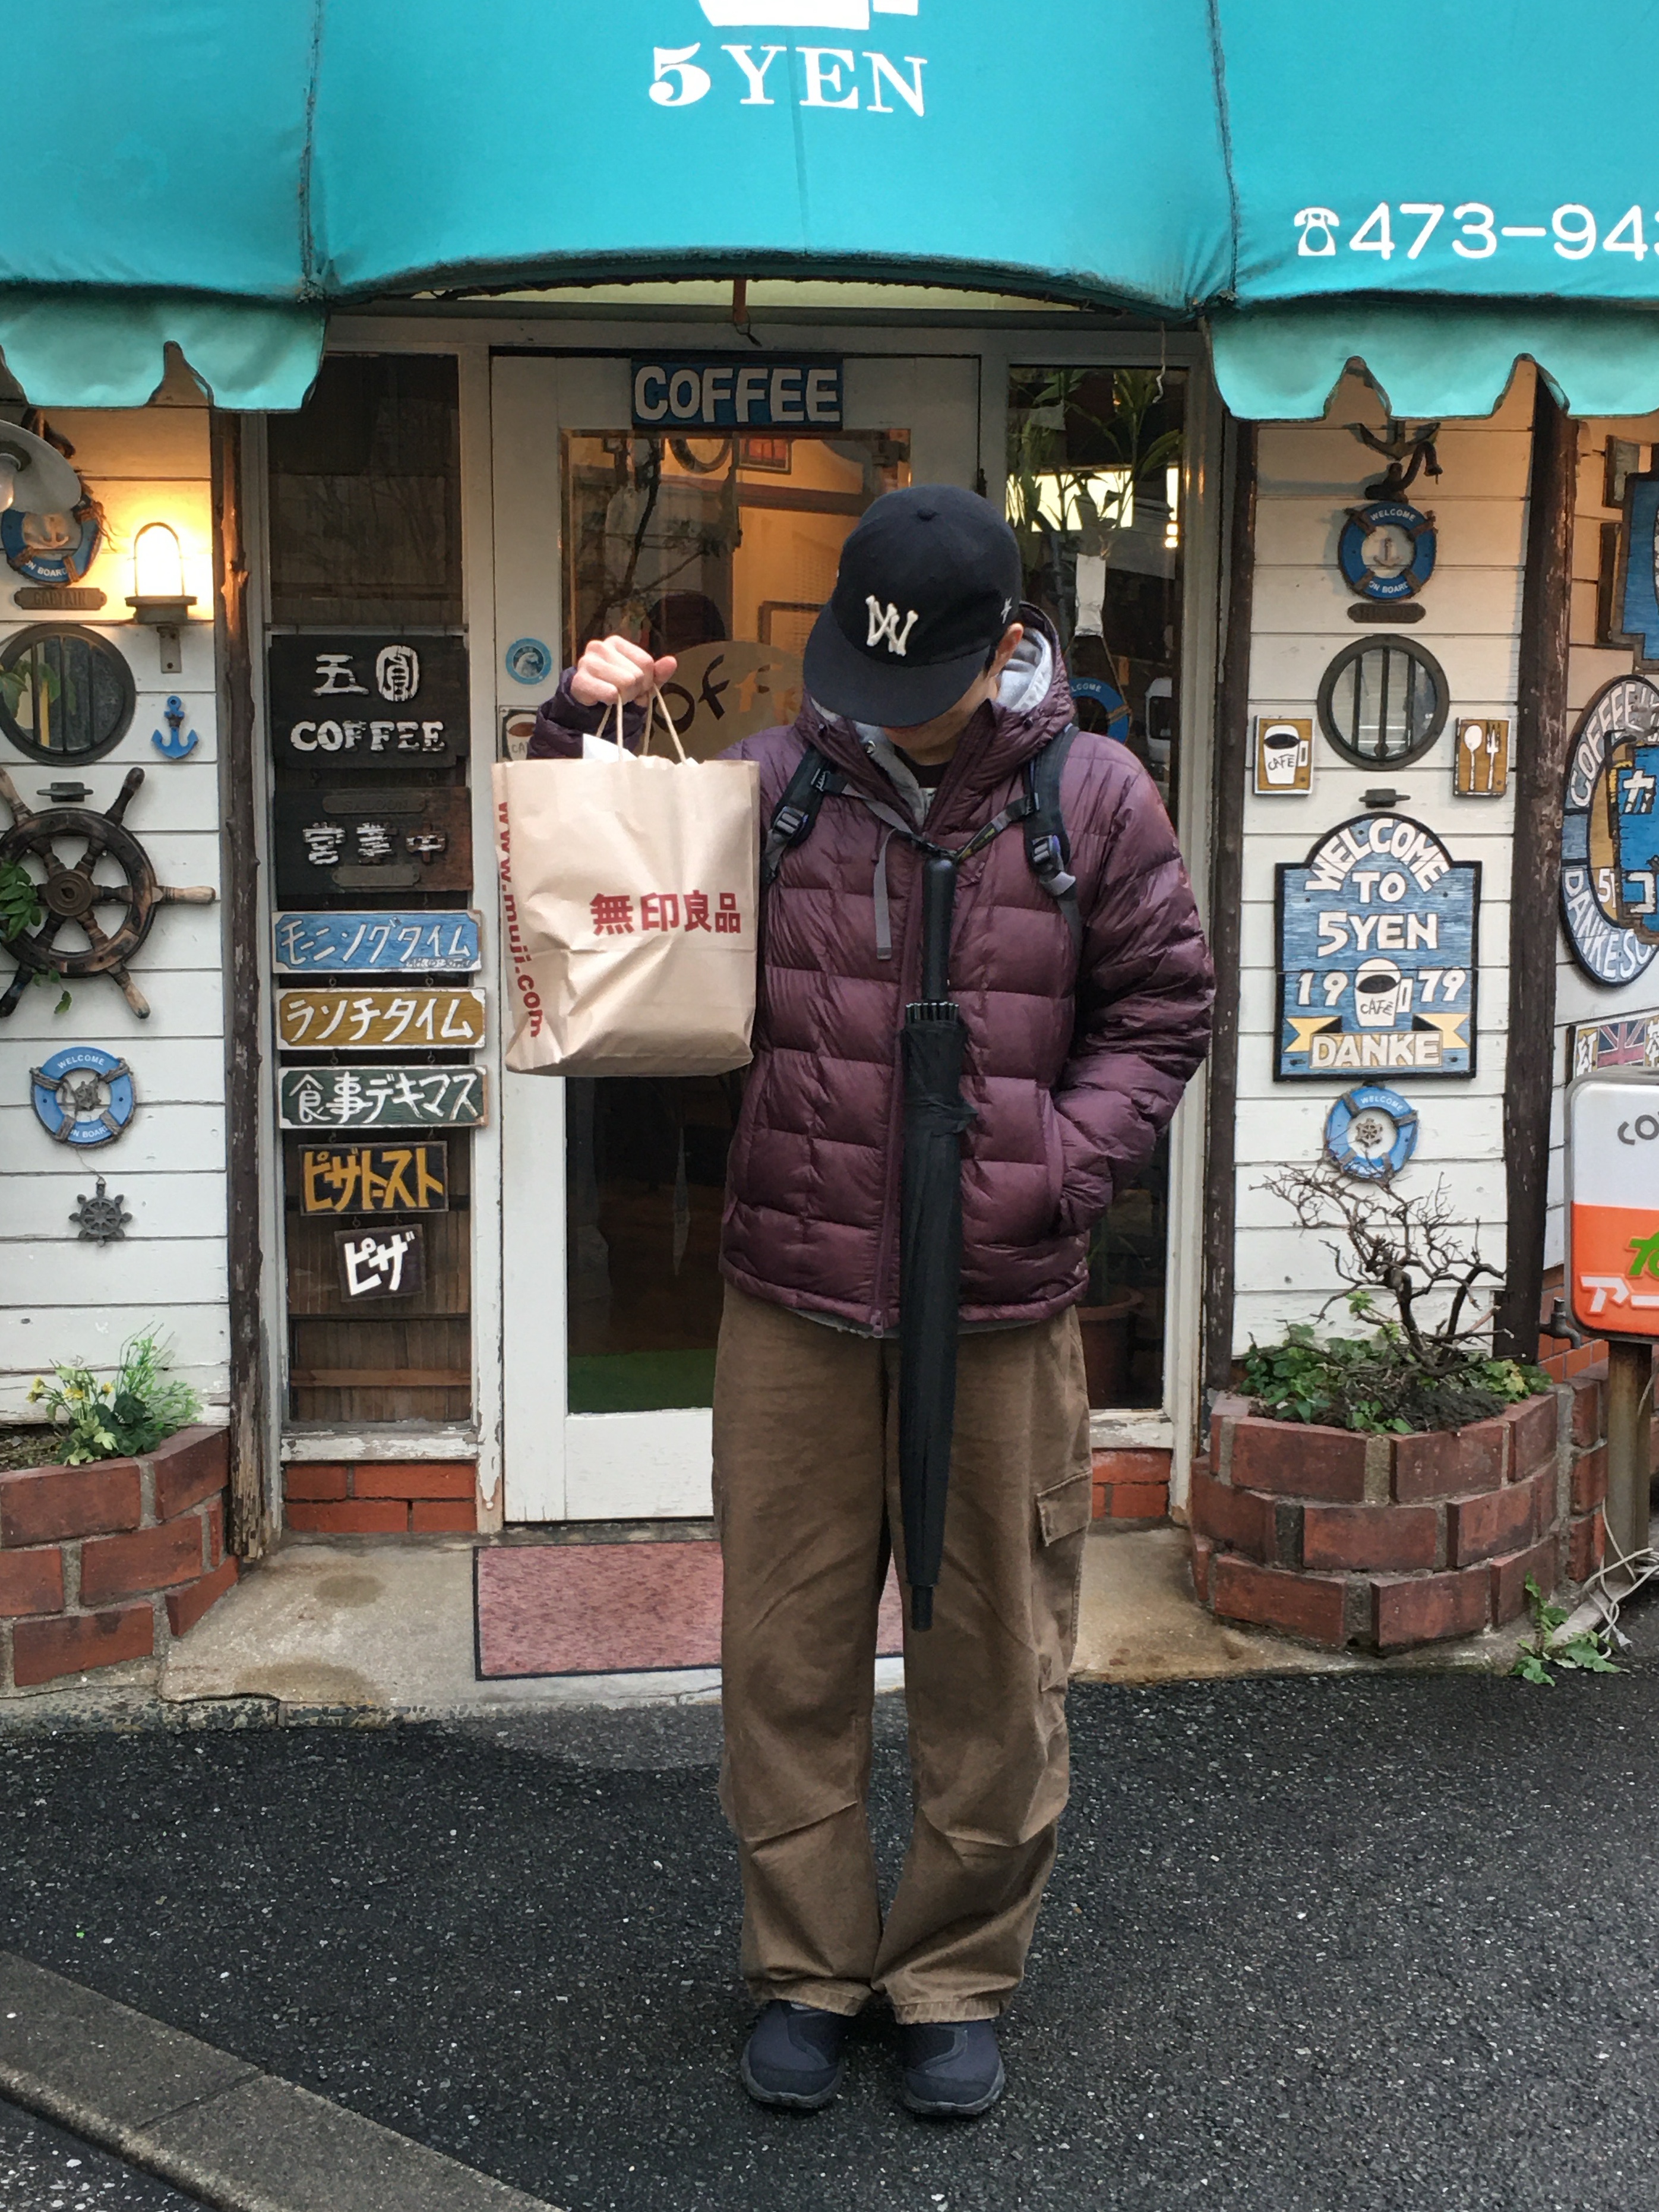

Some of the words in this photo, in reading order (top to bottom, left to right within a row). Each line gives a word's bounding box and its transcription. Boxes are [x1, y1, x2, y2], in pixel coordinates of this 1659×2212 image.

[1350, 202, 1659, 261] 473-94
[634, 365, 840, 423] COFFEE
[1370, 509, 1416, 522] WELCOME
[290, 720, 445, 752] COFFEE
[1304, 818, 1452, 892] WELCOME
[1351, 871, 1407, 904] TO
[498, 802, 545, 1038] www.muji.com
[589, 889, 741, 935] 無印良品
[1317, 910, 1439, 958] 5YEN
[1565, 868, 1619, 978] DANKE
[287, 997, 474, 1043] ランチタイム
[58, 1055, 105, 1069] WELCOME
[1312, 1034, 1441, 1067] DANKE
[289, 1071, 479, 1124] 食事デキマス
[1360, 1096, 1404, 1112] WELCOME
[304, 1147, 444, 1212] ピザトースト
[344, 1231, 415, 1296] ピザ
